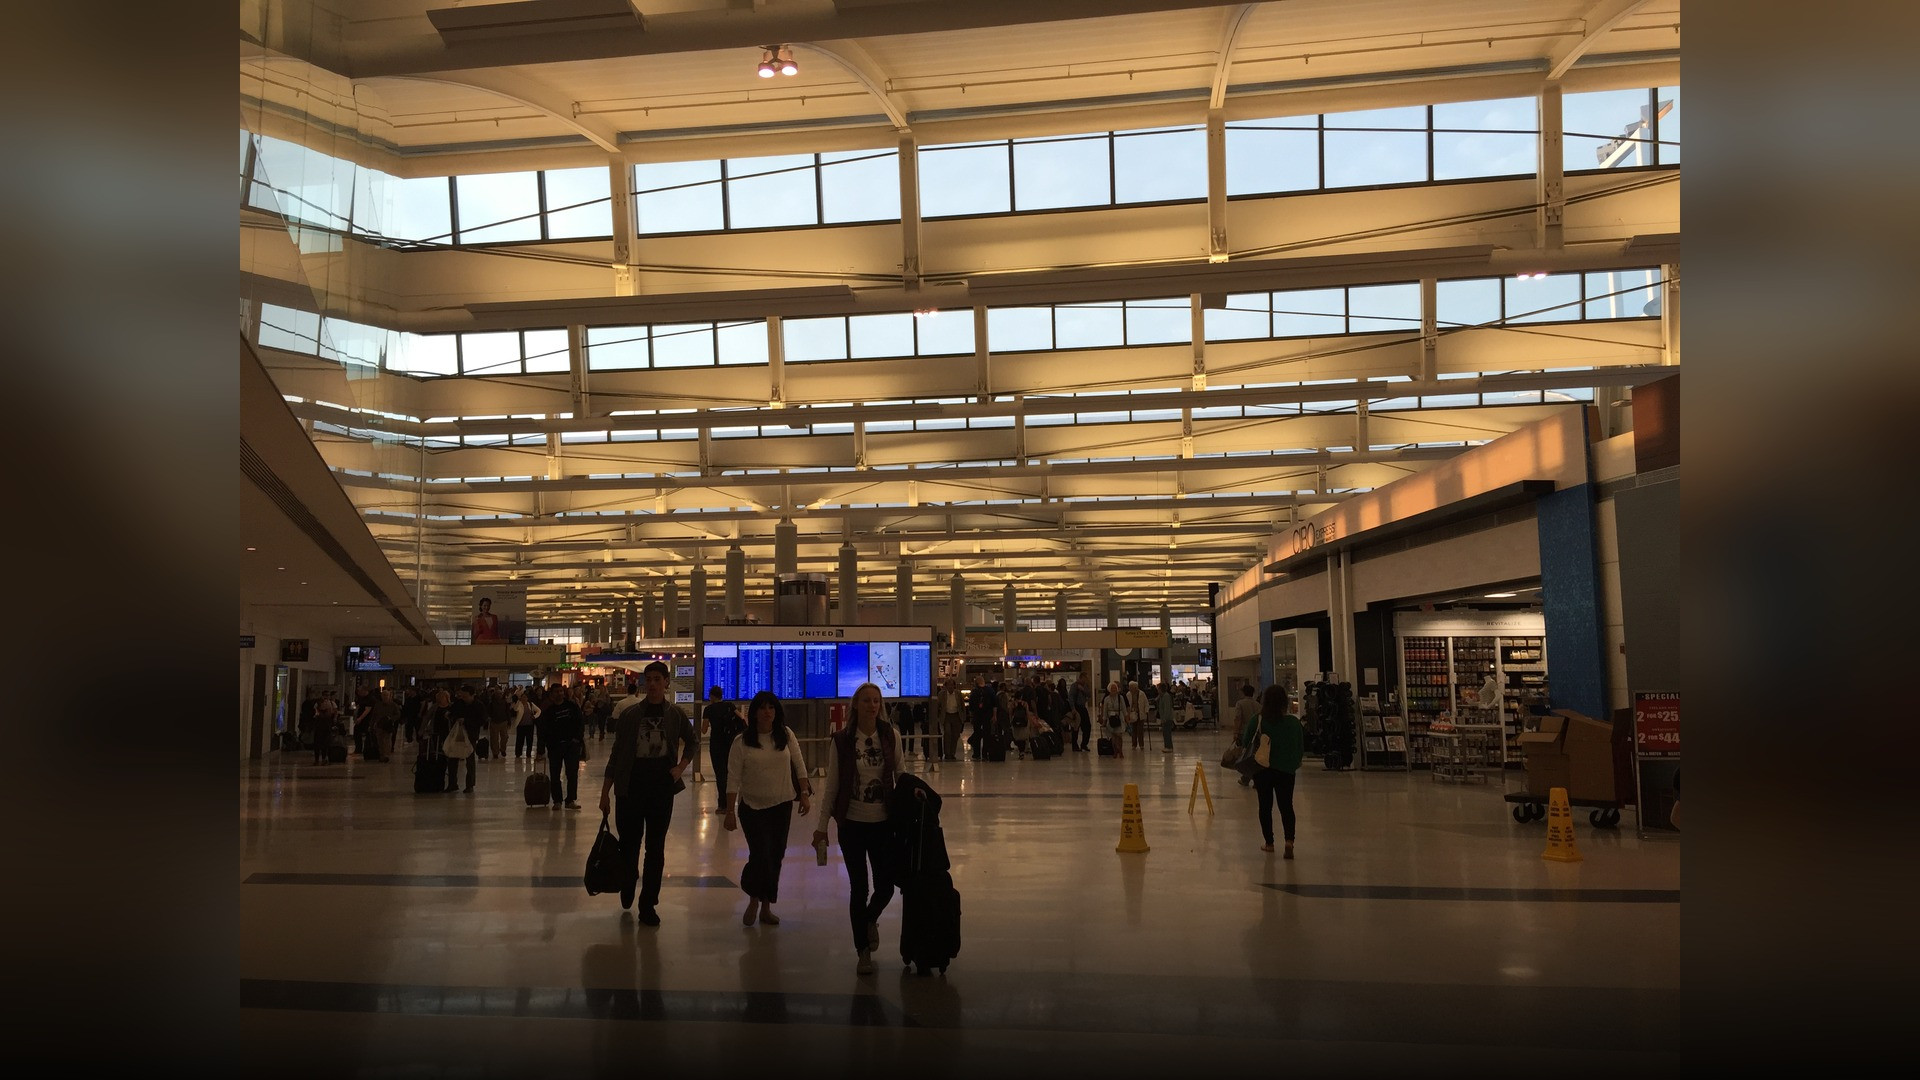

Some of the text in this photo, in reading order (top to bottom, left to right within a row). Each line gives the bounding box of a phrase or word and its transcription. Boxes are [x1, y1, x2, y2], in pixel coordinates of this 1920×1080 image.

[1292, 522, 1336, 555] CIBO EXPRESS
[1636, 710, 1645, 722] 2
[1638, 732, 1646, 744] 2
[1658, 732, 1680, 744] $44
